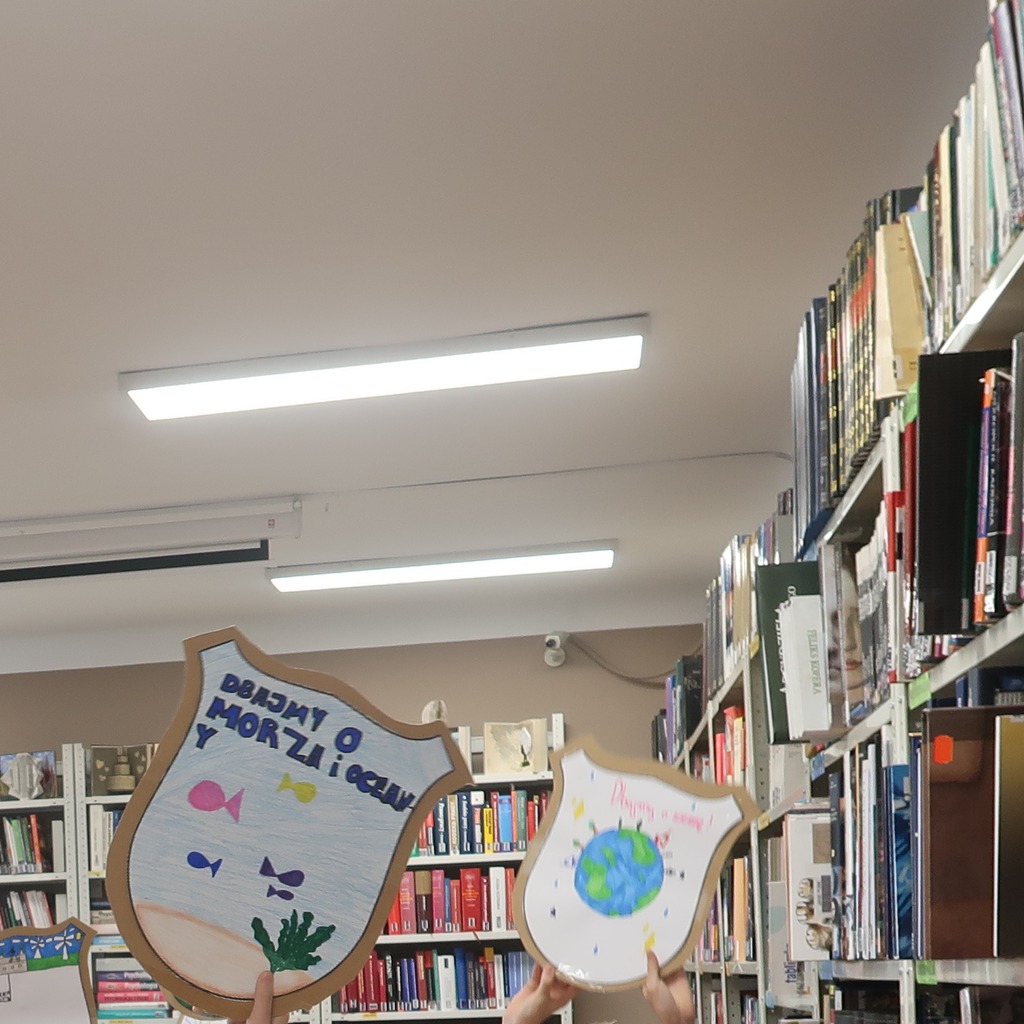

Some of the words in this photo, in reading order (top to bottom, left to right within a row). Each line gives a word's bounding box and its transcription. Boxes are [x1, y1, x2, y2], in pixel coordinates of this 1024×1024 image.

[195, 723, 219, 749] Y
[206, 696, 326, 770] MORZA
[221, 673, 328, 732] DBAJMY
[335, 726, 363, 753] O
